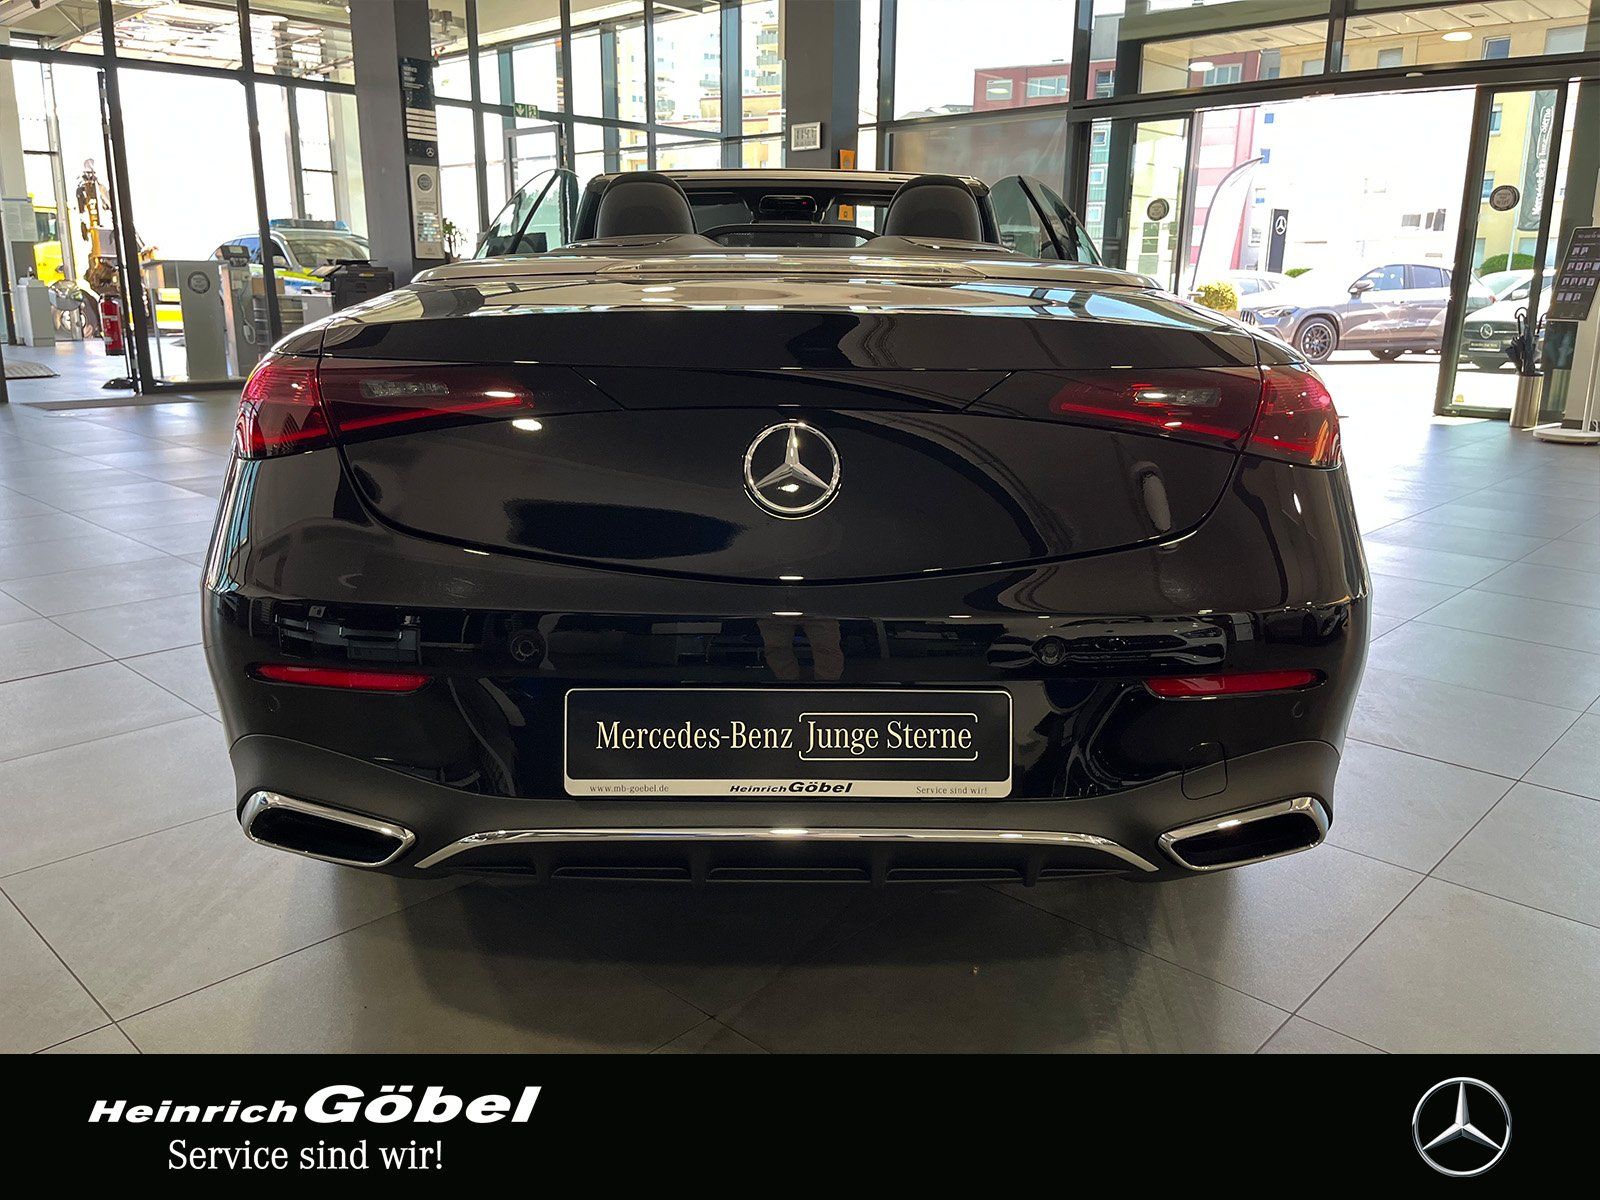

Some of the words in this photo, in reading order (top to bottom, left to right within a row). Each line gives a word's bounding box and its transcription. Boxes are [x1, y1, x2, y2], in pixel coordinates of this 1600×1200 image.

[595, 720, 793, 750] Mercedes-Benz
[805, 720, 879, 755] Junge
[886, 720, 972, 749] Sterne
[589, 784, 669, 793] www.mb-goebel.de
[729, 784, 787, 793] Heinrich
[788, 781, 853, 793] Göbel
[916, 785, 948, 794] Service
[949, 786, 968, 795] sind
[970, 786, 988, 795] wir!
